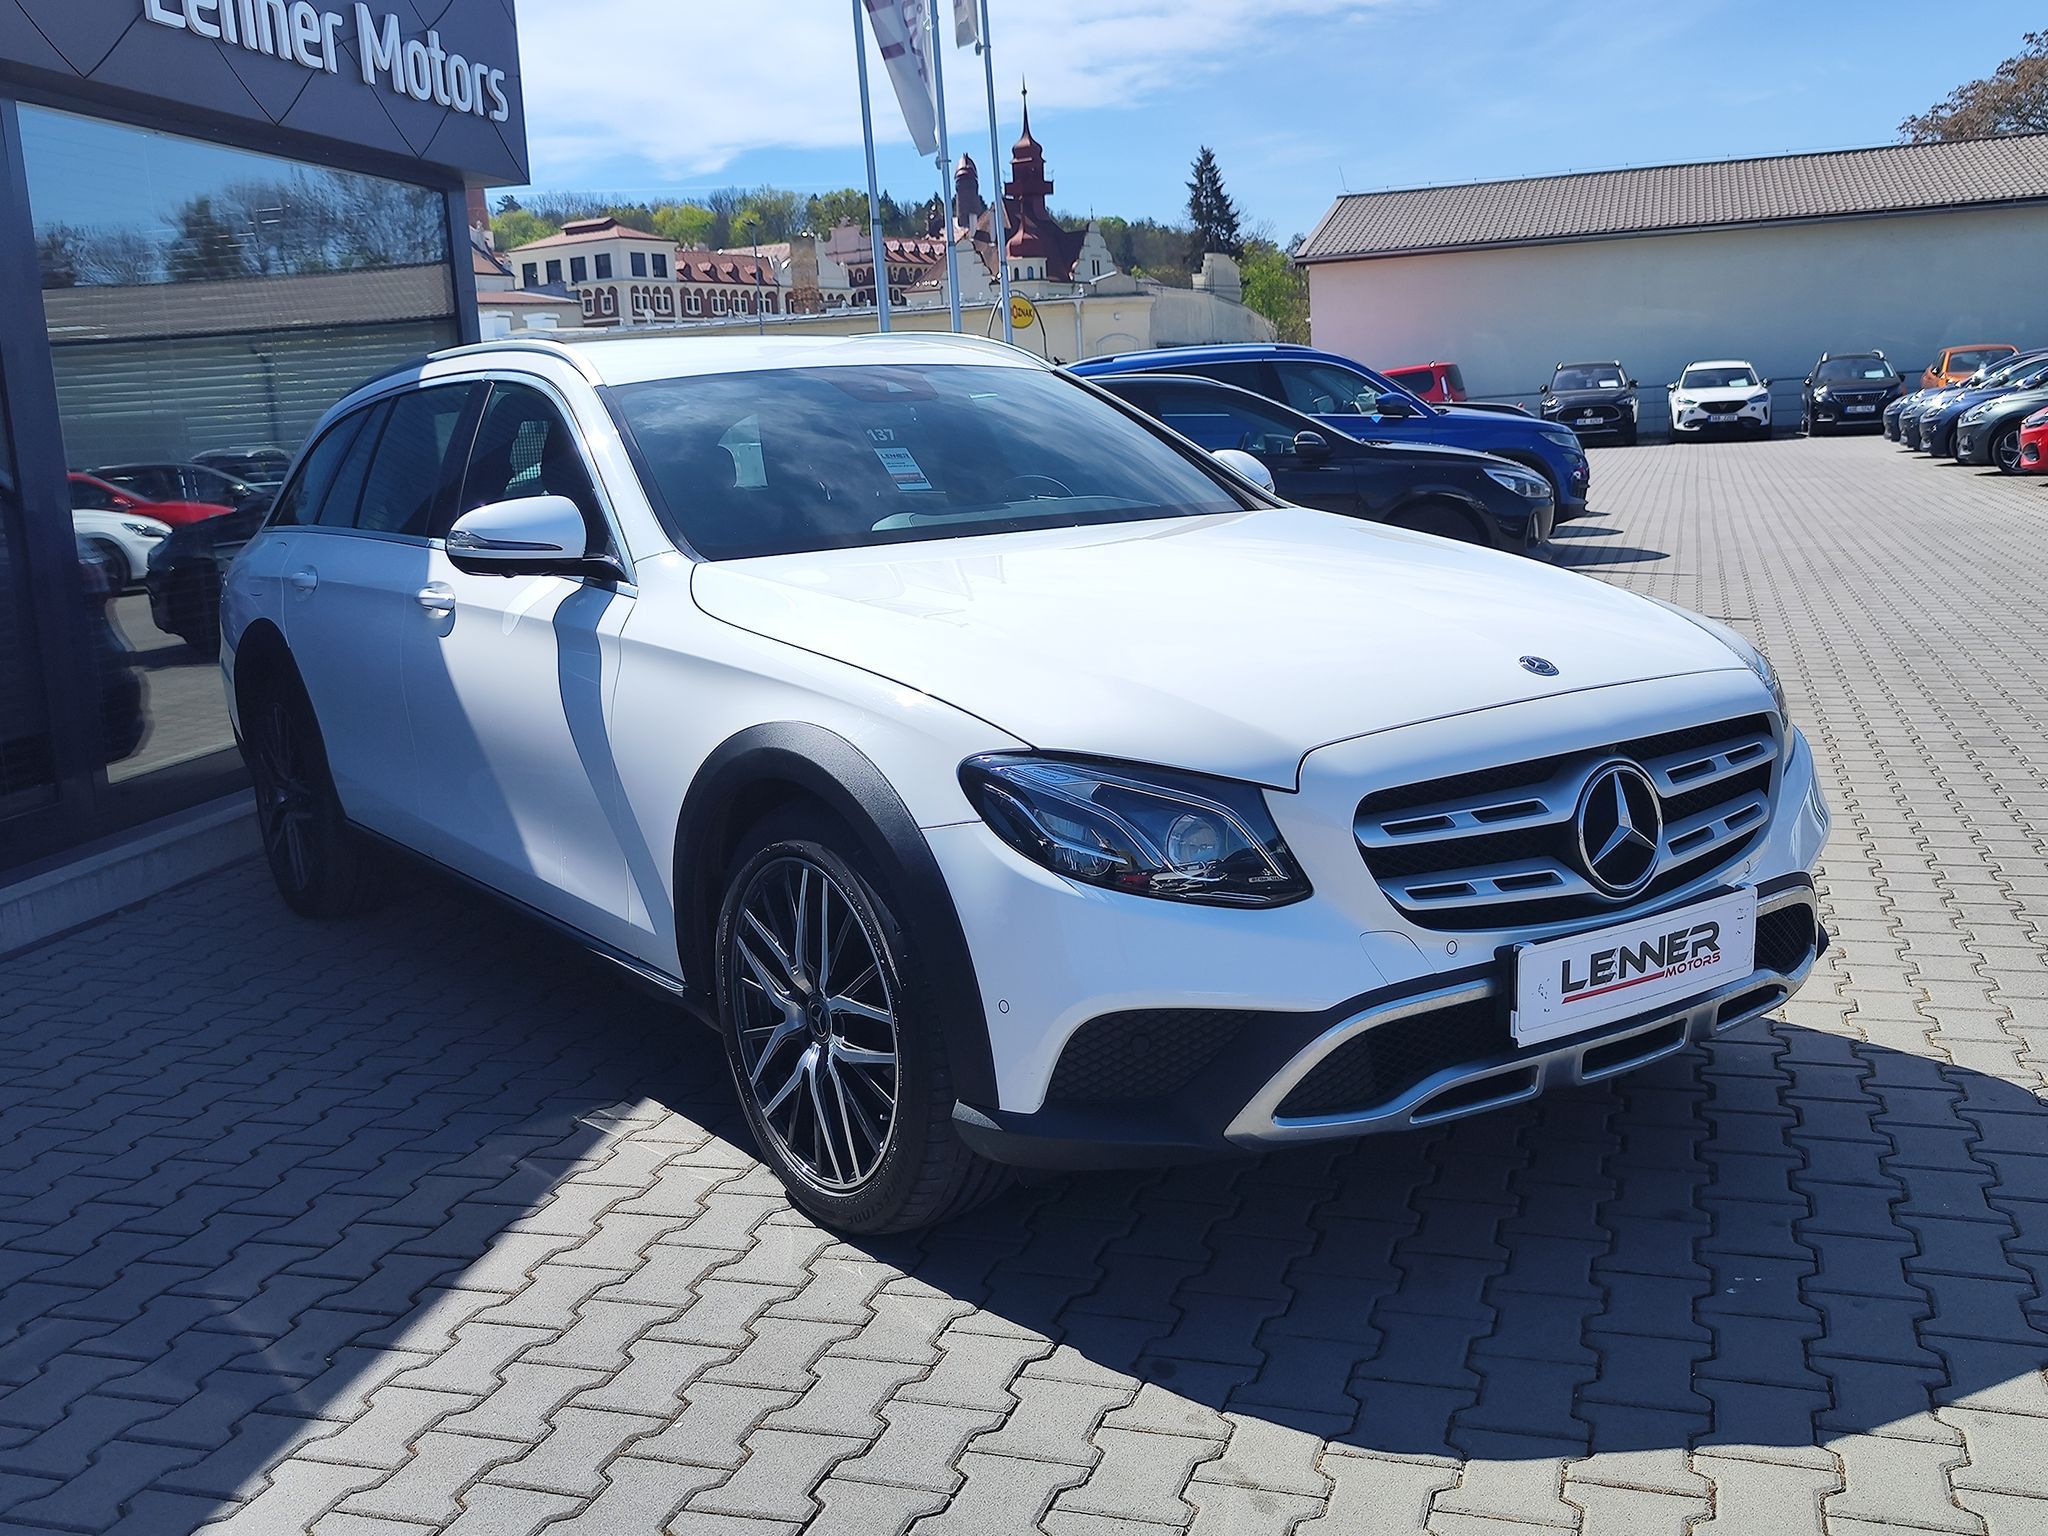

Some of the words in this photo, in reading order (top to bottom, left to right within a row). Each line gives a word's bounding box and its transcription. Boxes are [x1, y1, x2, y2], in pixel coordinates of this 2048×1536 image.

[354, 2, 509, 122] Motors
[866, 428, 894, 441] 137
[1561, 920, 1721, 994] LENNER
[1664, 952, 1721, 979] MOTORS
